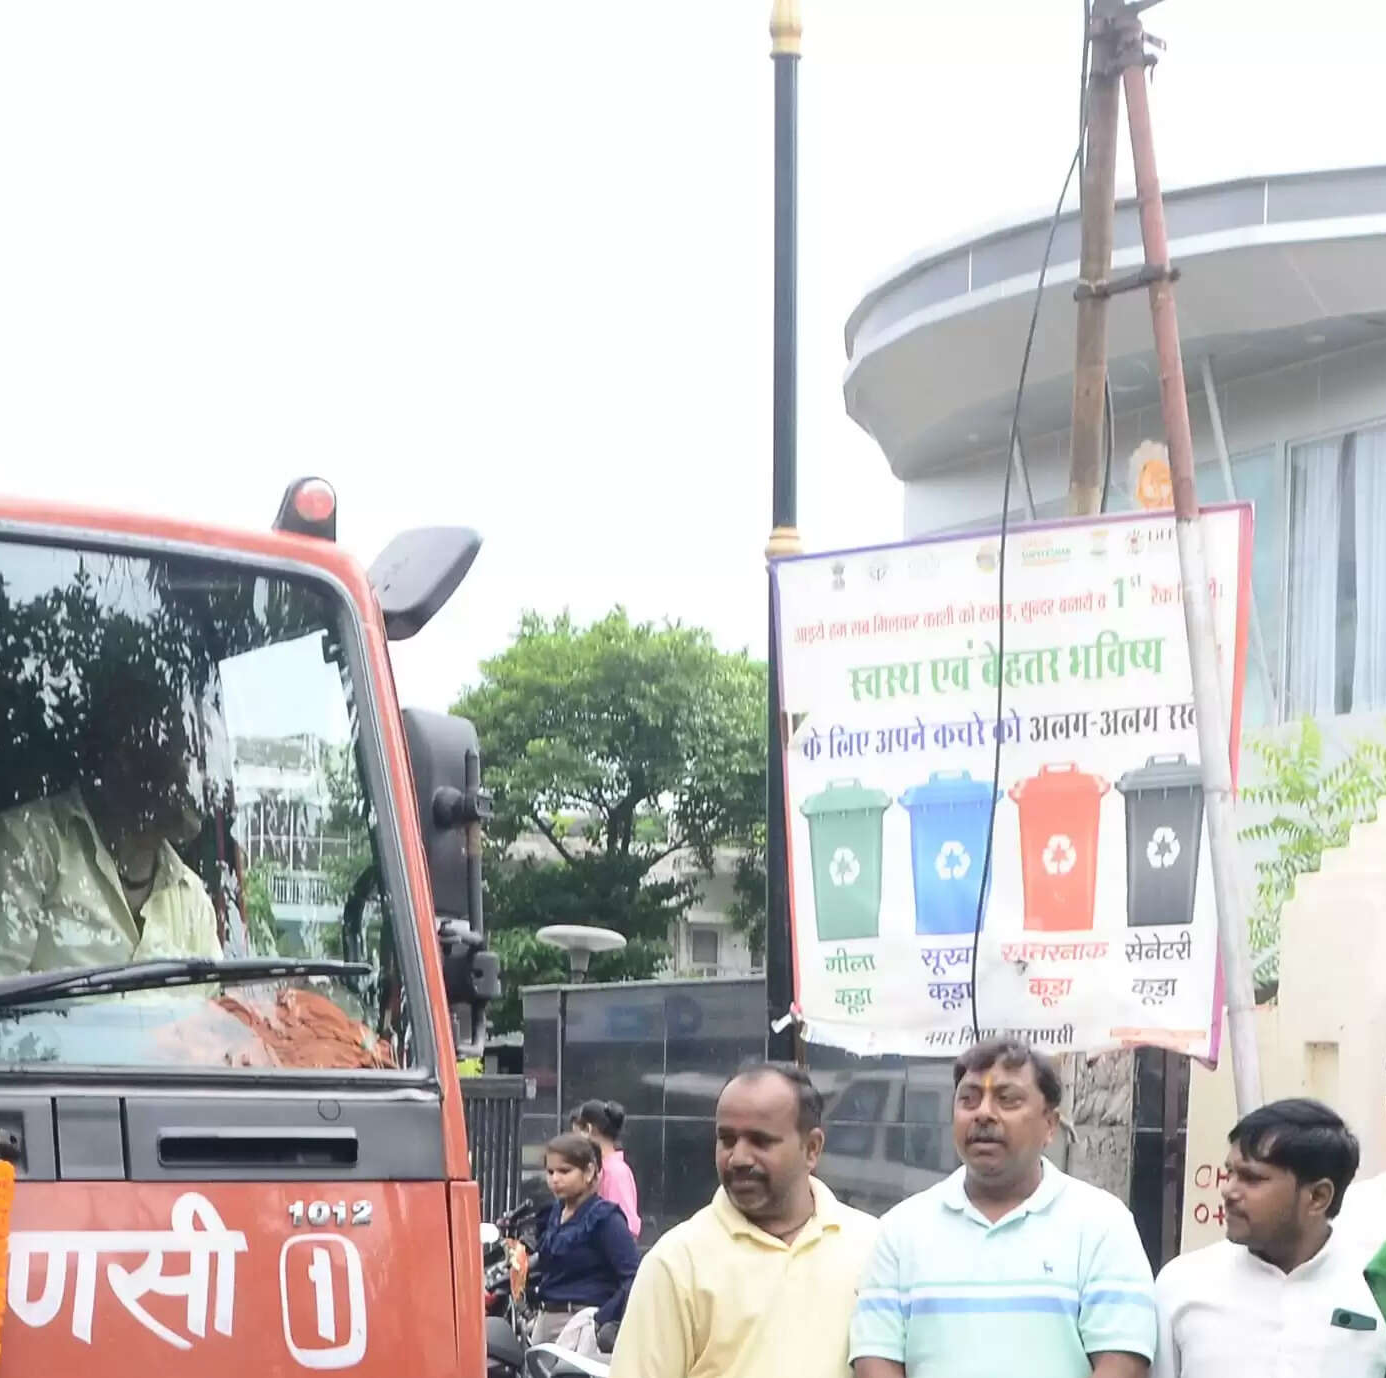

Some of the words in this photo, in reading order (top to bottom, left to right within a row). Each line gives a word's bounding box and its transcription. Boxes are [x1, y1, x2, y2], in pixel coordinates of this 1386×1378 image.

[959, 599, 976, 625] को
[929, 639, 974, 694] एवं
[978, 639, 1058, 690] बेहतर
[1069, 629, 1165, 680] भविष्य
[802, 727, 823, 760] के
[828, 723, 871, 758] लिए
[875, 715, 926, 753] अपने
[931, 711, 987, 748] कचरे
[991, 707, 1022, 744] को
[1029, 705, 1161, 742] अलग-अलग
[824, 947, 876, 974] गीला
[921, 947, 973, 975] सूख
[1124, 931, 1192, 963] सेनेटरी
[834, 987, 873, 1015] कूड़ा
[928, 981, 973, 1010] कूड़ा
[1028, 977, 1073, 1008] कूड़ा
[1132, 978, 1177, 1006] कूड़ा
[288, 1200, 374, 1227] 1012
